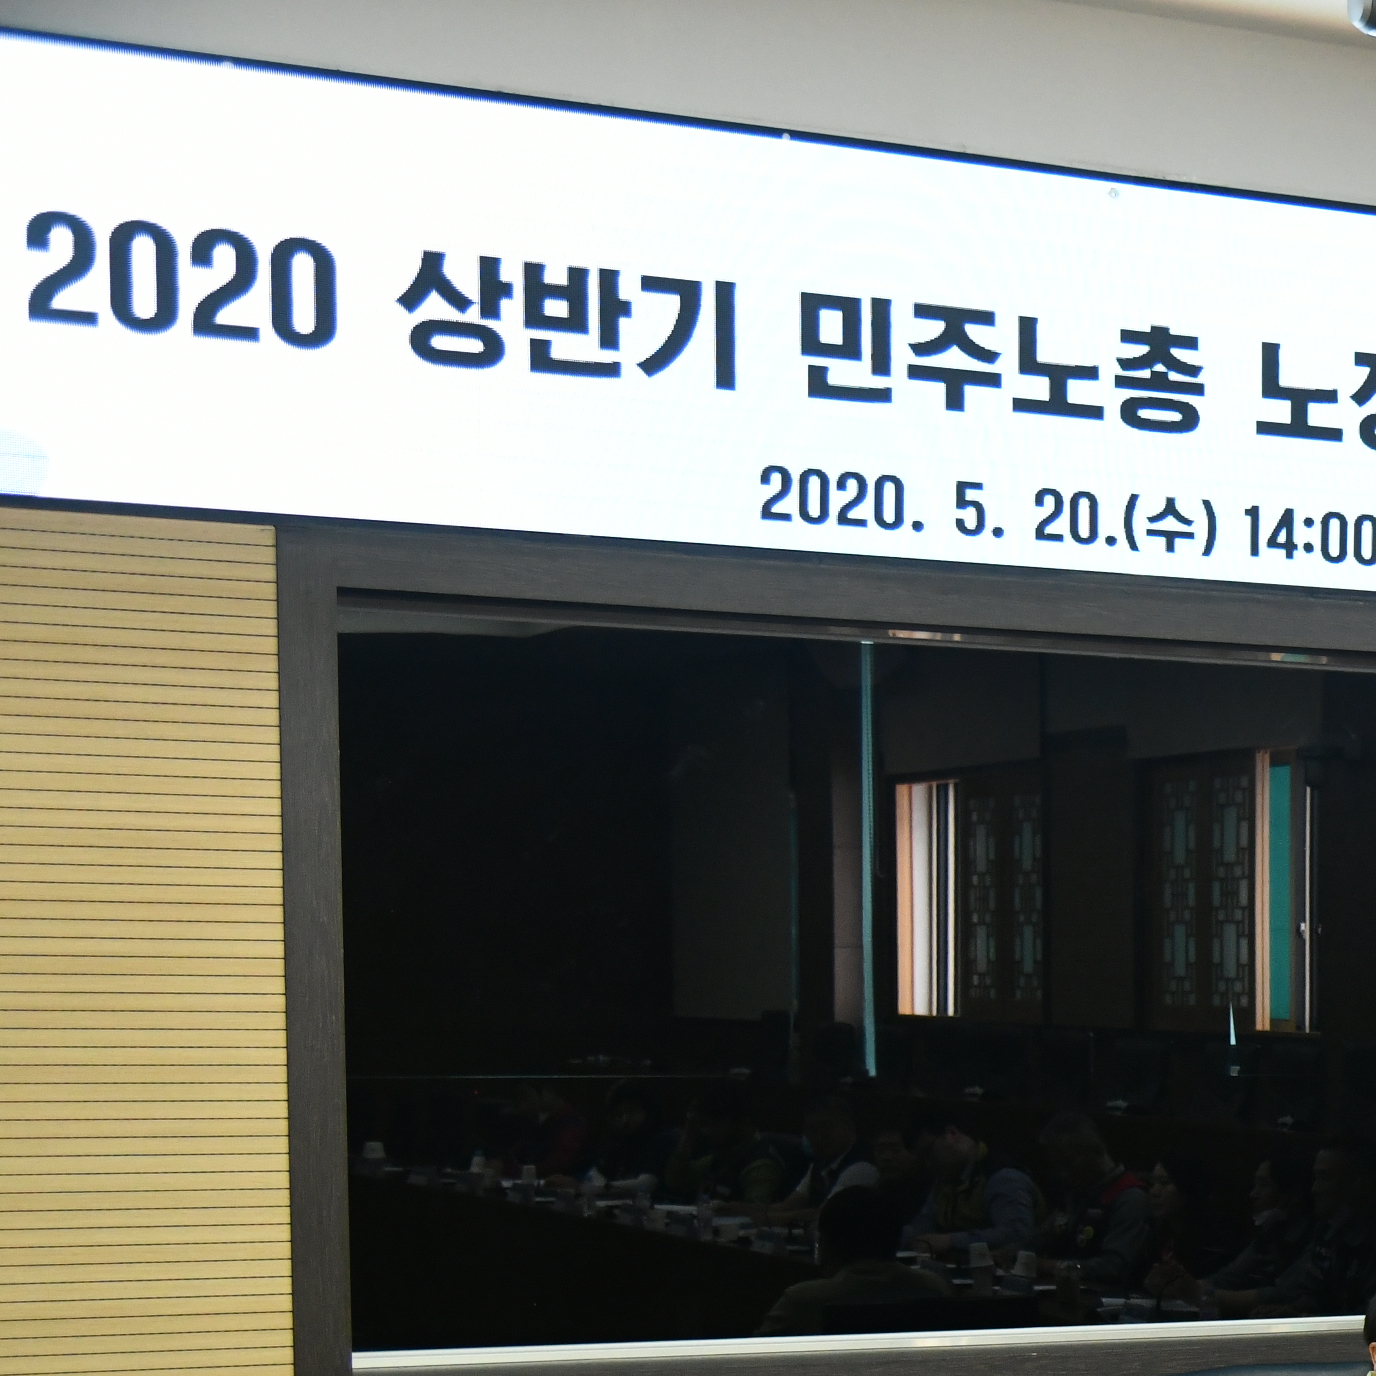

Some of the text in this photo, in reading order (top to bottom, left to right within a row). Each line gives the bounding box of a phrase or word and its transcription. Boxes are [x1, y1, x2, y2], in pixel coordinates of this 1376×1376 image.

[26, 211, 337, 349] 2020
[396, 250, 737, 391] 상반기
[800, 291, 1205, 434] 민주노총
[760, 465, 924, 533] 2020.
[955, 480, 1004, 539] 5.
[1034, 487, 1217, 557] 20.(수)
